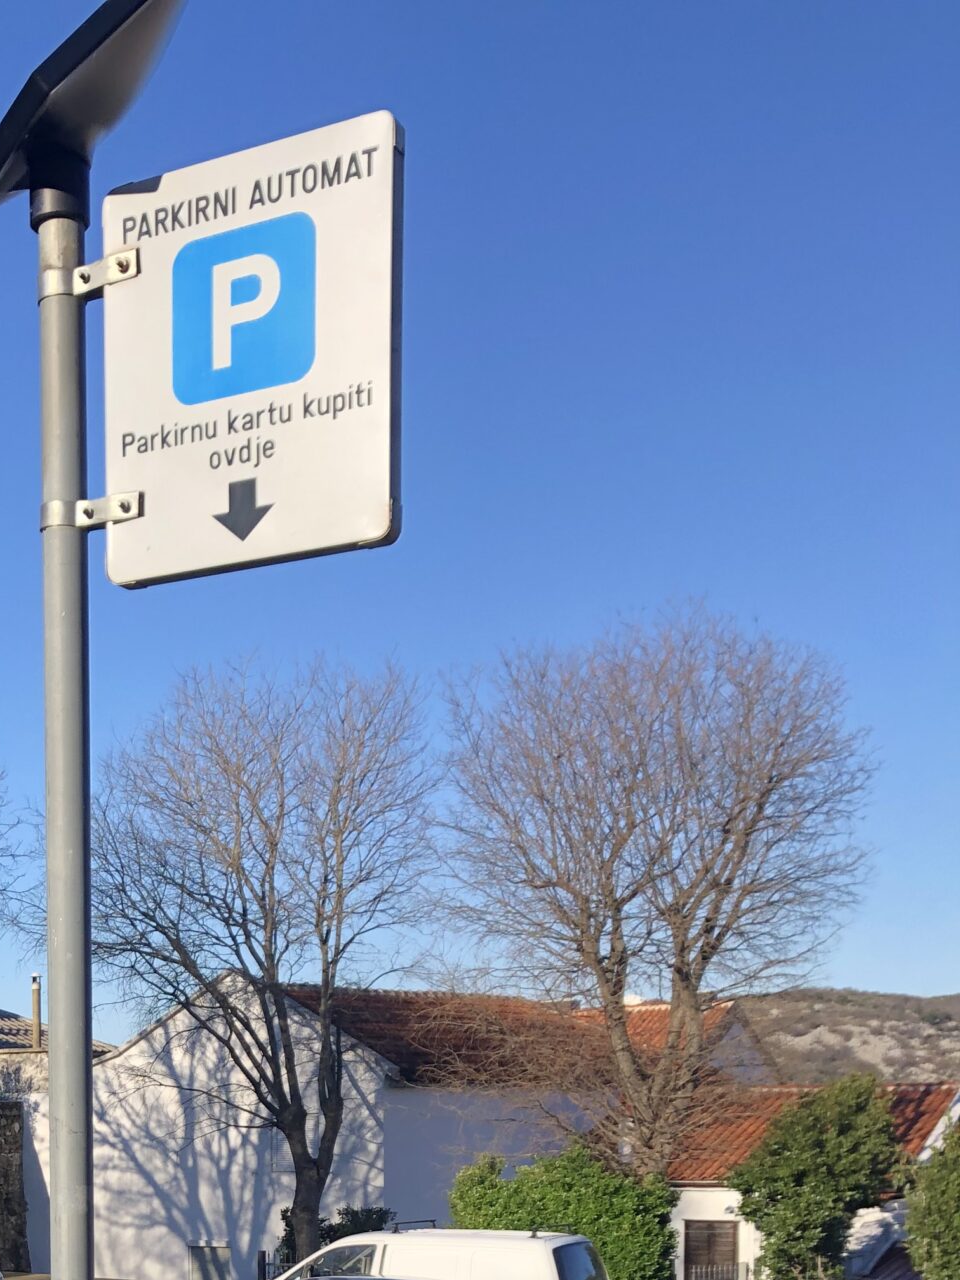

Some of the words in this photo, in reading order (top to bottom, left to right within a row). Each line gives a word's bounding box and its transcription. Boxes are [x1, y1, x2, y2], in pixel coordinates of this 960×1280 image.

[121, 187, 238, 245] PARKIRNI
[248, 146, 379, 211] AUTOMAT
[212, 253, 281, 371] P
[121, 416, 218, 458] Parkirnu
[227, 402, 292, 436] kartu
[302, 380, 374, 420] kupiti
[208, 436, 276, 471] ovdje
